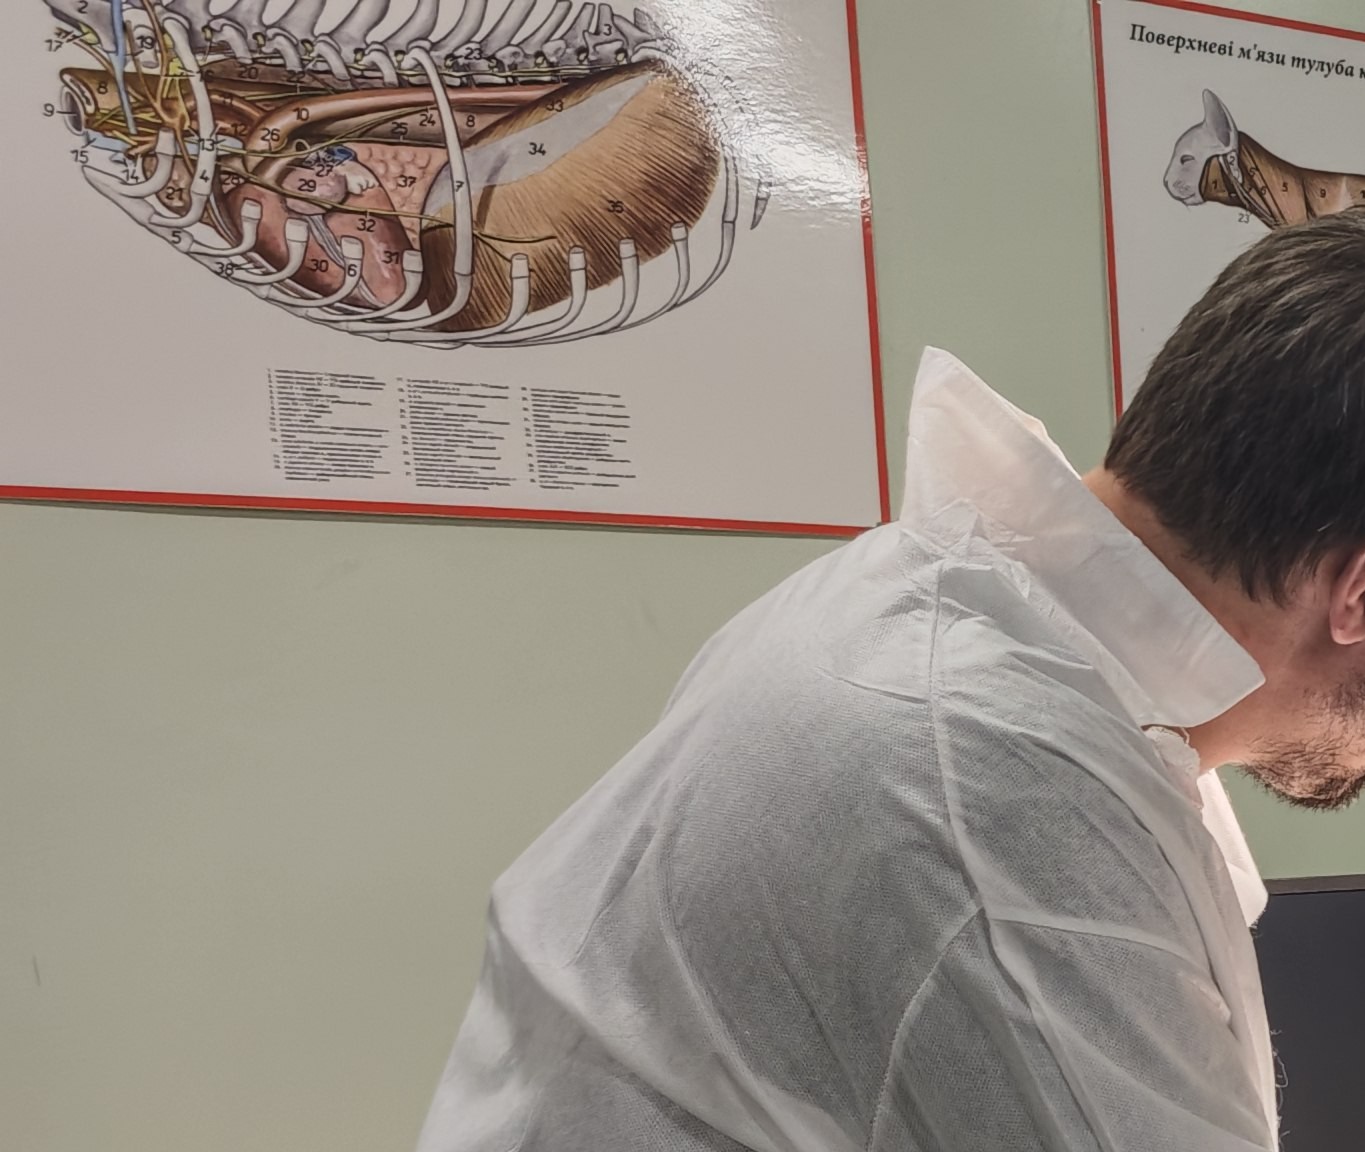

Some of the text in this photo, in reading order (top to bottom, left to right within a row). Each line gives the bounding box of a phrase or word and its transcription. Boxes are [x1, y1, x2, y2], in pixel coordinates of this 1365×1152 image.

[77, 0, 88, 14] 2
[602, 24, 612, 36] 3
[464, 47, 482, 61] 23
[1129, 23, 1234, 57] Поверхневі
[1238, 44, 1286, 66] м'язи
[1291, 55, 1355, 79] тулуба
[97, 82, 108, 95] 8
[43, 103, 56, 117] 9
[293, 108, 310, 121] 10
[419, 113, 436, 127] 24
[465, 114, 476, 127] 8
[260, 128, 281, 142] 26
[391, 122, 409, 136] 25
[200, 138, 216, 152] 13
[528, 142, 547, 156] 34
[70, 150, 89, 164] 15
[122, 169, 140, 183] 14
[199, 169, 210, 183] 4
[315, 163, 334, 178] 27
[298, 178, 317, 193] 29
[398, 174, 417, 188] 37
[455, 181, 465, 192] 7
[166, 186, 184, 201] 21
[607, 200, 624, 213] 35
[357, 218, 376, 232] 32
[171, 230, 182, 245] 5
[382, 251, 400, 265] 31
[215, 262, 234, 277] 38
[309, 258, 329, 273] 30
[347, 264, 357, 278] 6
